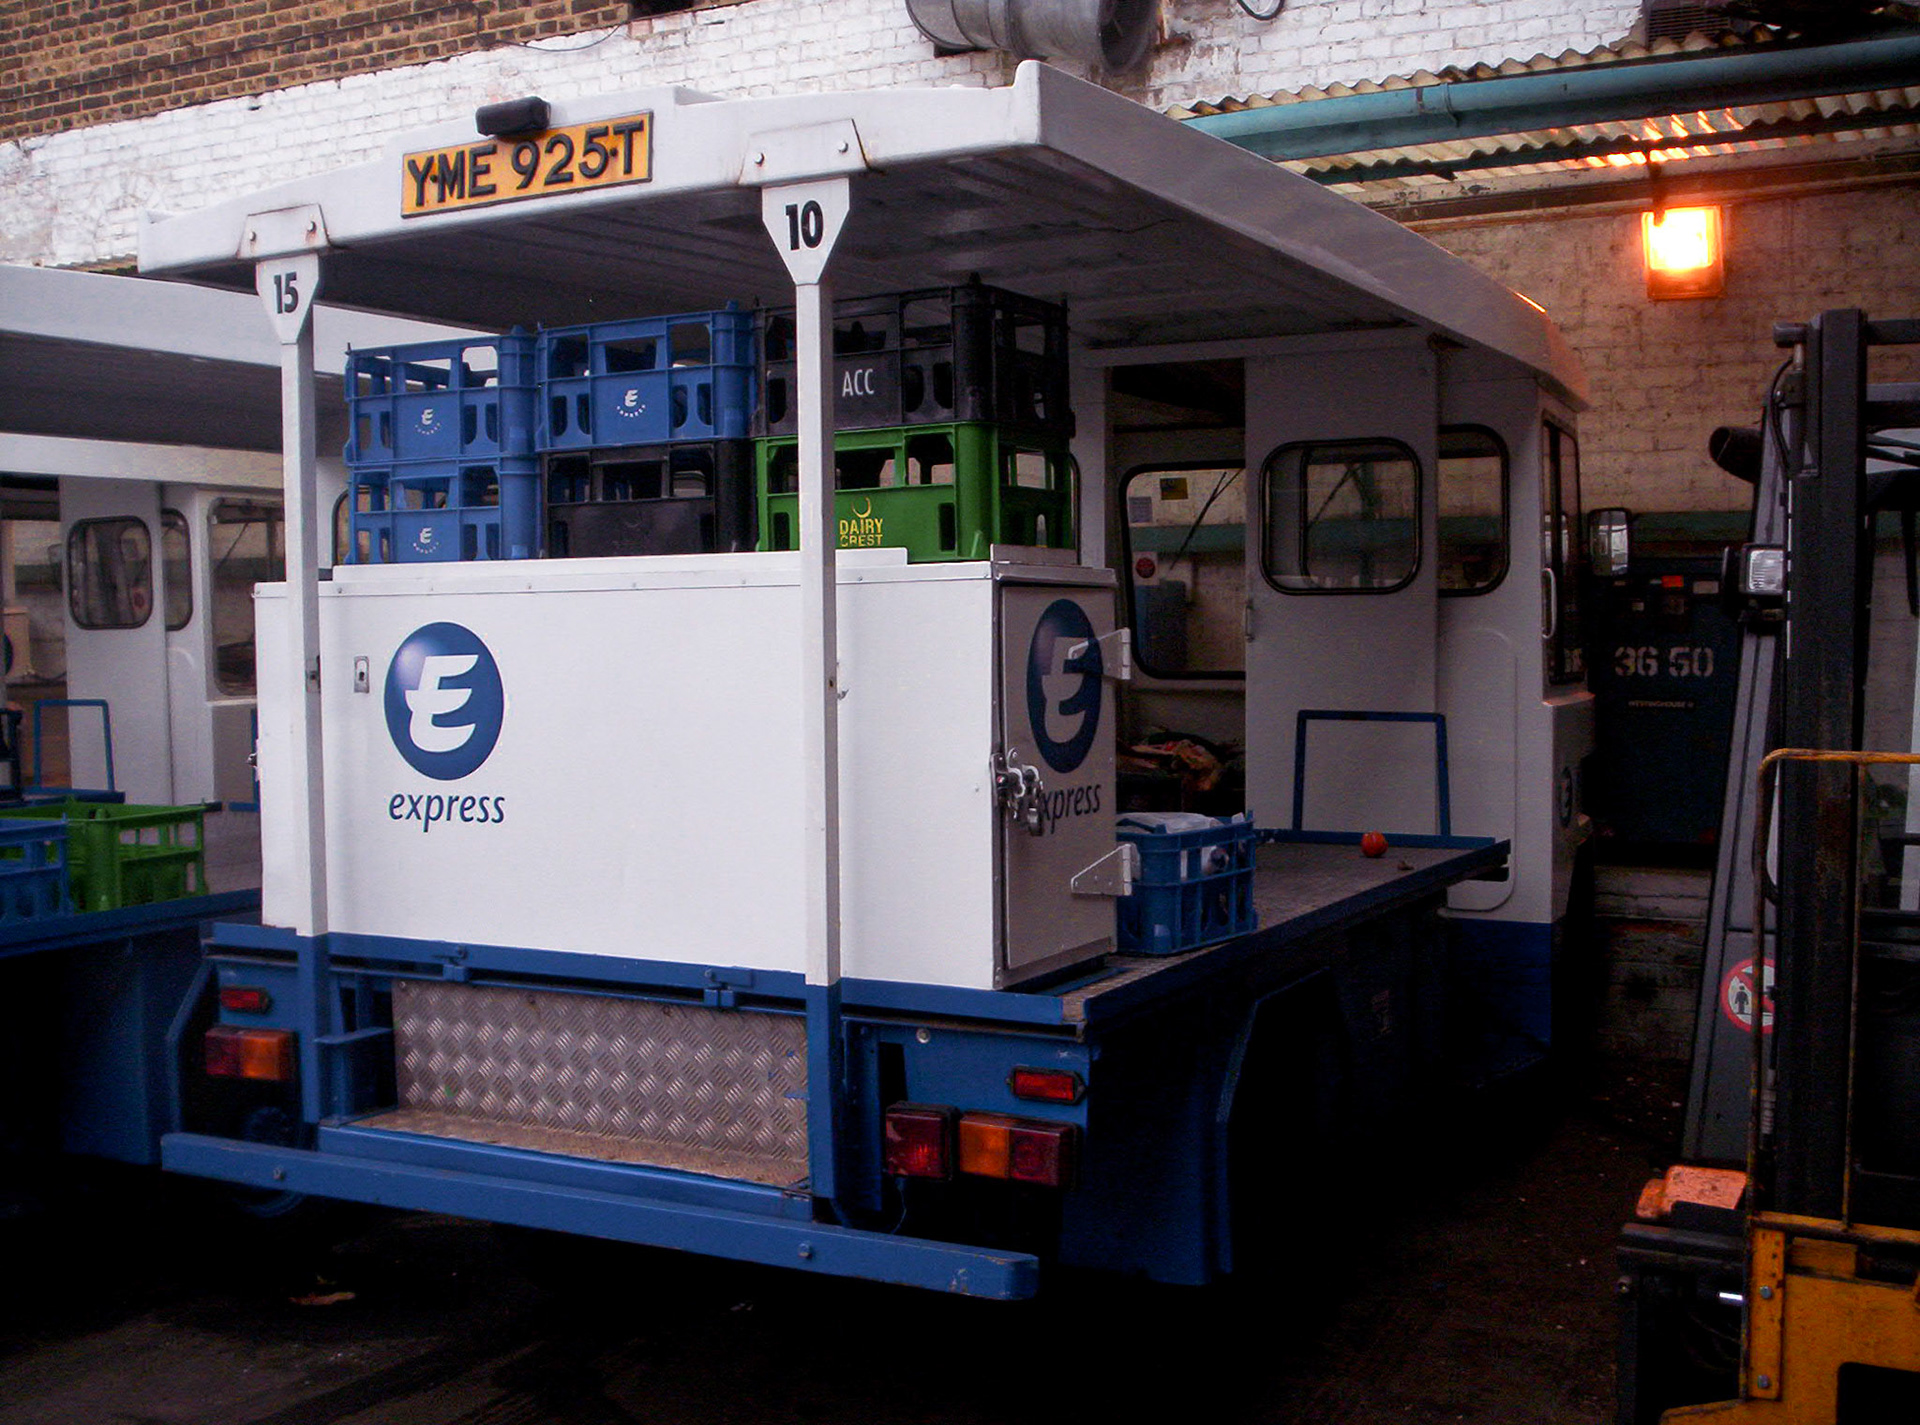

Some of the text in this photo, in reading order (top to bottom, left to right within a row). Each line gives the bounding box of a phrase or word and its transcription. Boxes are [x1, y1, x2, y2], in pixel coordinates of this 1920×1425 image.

[785, 200, 823, 251] 10
[274, 271, 298, 314] 15
[842, 368, 874, 397] ACC
[840, 518, 883, 535] DAIRY
[840, 534, 883, 547] CREST
[1668, 646, 1714, 677] 50
[388, 793, 505, 833] express
[1040, 784, 1101, 834] xpress
